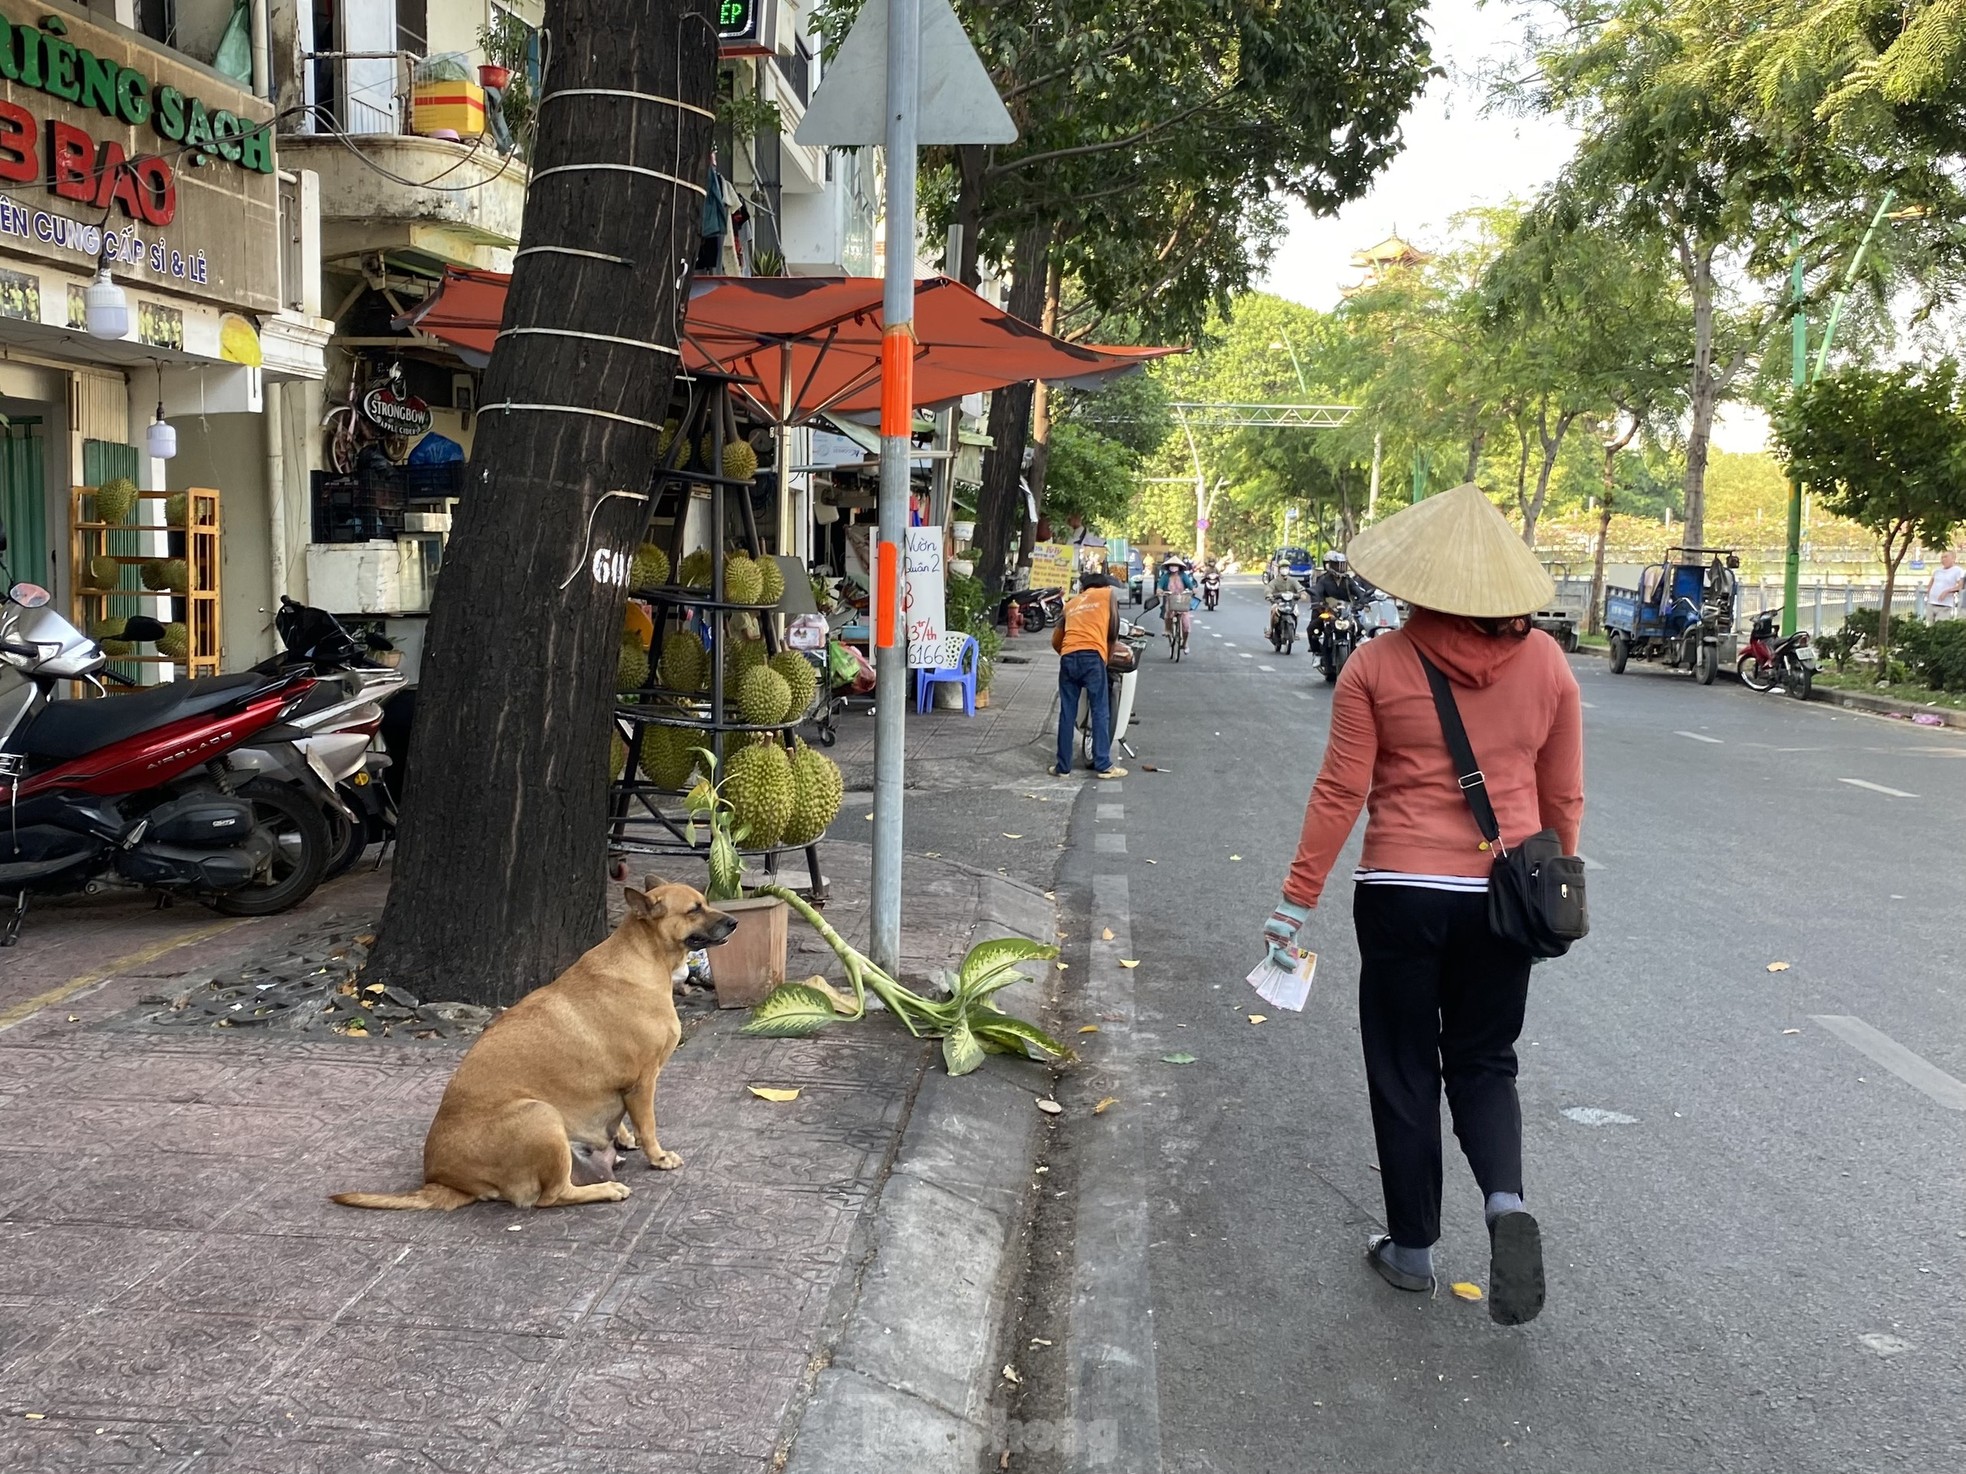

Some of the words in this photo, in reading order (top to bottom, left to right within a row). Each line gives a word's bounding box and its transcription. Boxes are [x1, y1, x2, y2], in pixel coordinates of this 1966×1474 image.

[158, 85, 275, 174] SẠCH
[50, 119, 177, 227] BAO
[33, 211, 101, 256] CUNG
[103, 224, 146, 265] CẤP
[150, 237, 167, 273] SỈ
[171, 250, 186, 278] &
[188, 248, 207, 285] LẺ
[371, 399, 426, 424] STRONGBOW
[380, 421, 398, 433] APPLE
[930, 553, 941, 573] 2
